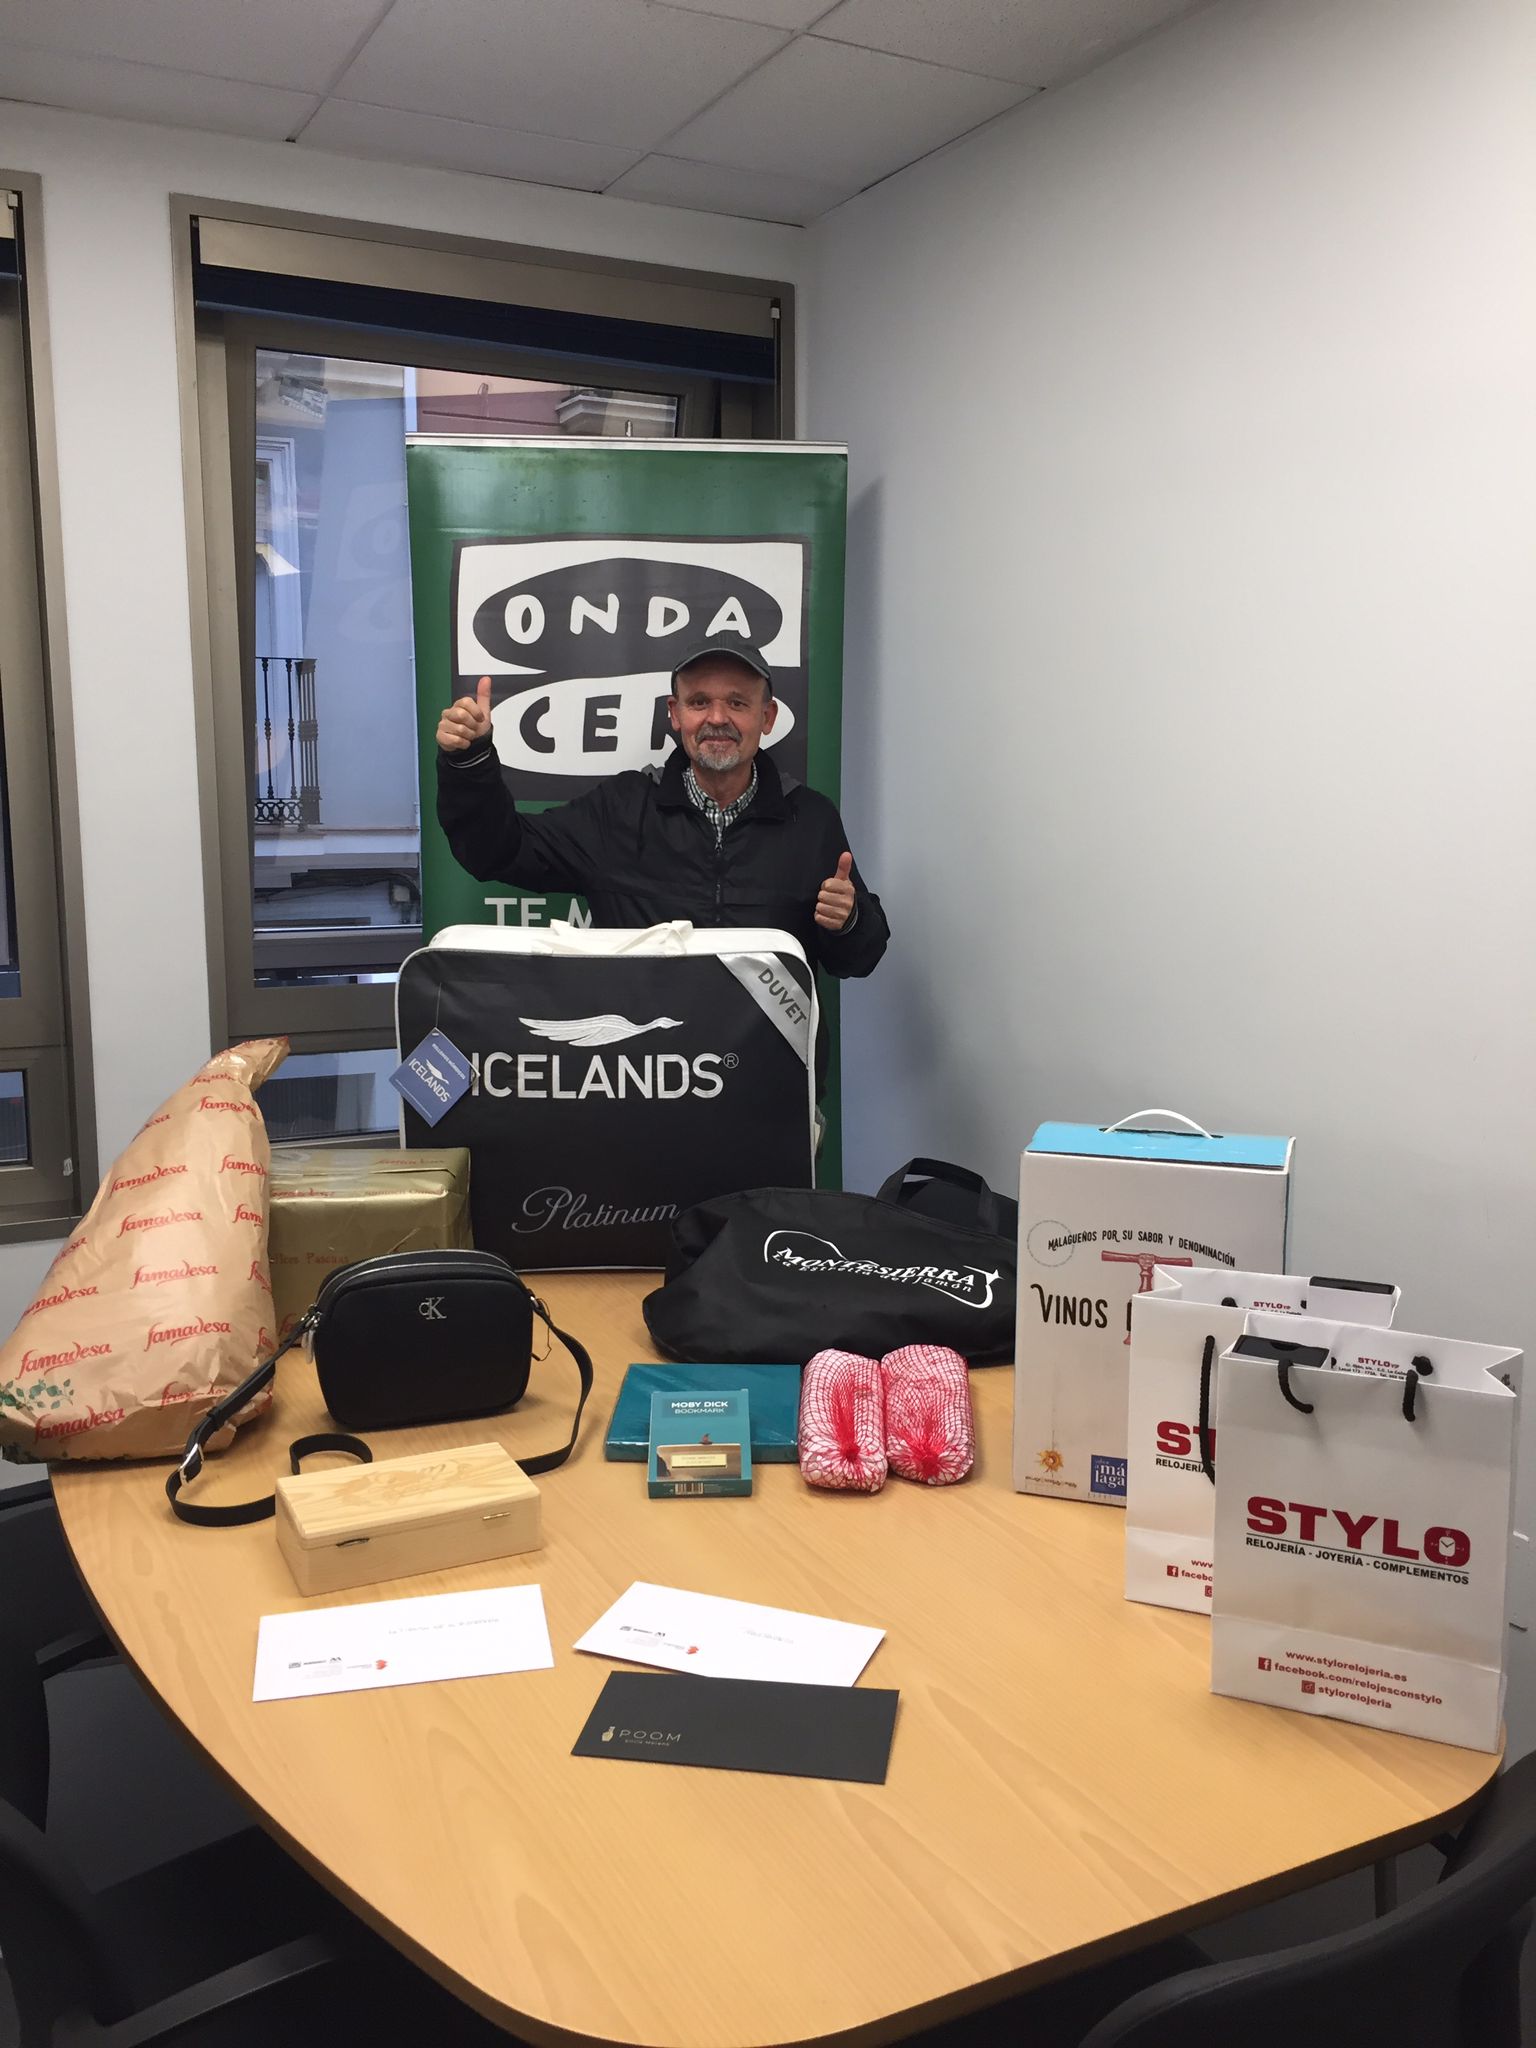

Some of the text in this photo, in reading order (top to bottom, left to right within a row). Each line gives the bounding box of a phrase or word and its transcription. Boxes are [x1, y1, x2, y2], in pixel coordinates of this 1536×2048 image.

[504, 593, 752, 644] ONDA
[758, 968, 807, 1024] DUVET
[408, 1058, 450, 1103] ICELANDS
[108, 1165, 188, 1200] famadesa
[116, 1207, 203, 1239] famadesa
[512, 1186, 680, 1234] Platinum
[777, 1247, 974, 1286] MONTESIERRA
[1048, 1230, 1236, 1267] MALAGUEÑOS POR SU SABOR Y DENOMINACIÓN
[130, 1260, 219, 1290] famadesa
[1030, 1283, 1108, 1329] VINOS
[1253, 1301, 1283, 1309] STYLO
[144, 1316, 231, 1352] famadesa
[15, 1342, 112, 1380] famadesa
[1357, 1357, 1391, 1368] STYLO
[671, 1400, 729, 1409] MOBY DICK
[674, 1407, 725, 1415] BOOKMARK
[33, 1405, 125, 1445] famadesa
[1247, 1496, 1471, 1568] STYLO
[1246, 1537, 1306, 1556] RELOJERÍA
[1315, 1550, 1364, 1567] JOYERÍA
[1373, 1560, 1470, 1585] COMPLEMENTOS
[1274, 1662, 1443, 1705] facebook.com/relojesconstylo
[1286, 1651, 1407, 1682] www.stylorelojeria.es
[1318, 1685, 1392, 1709] stylorelojeria
